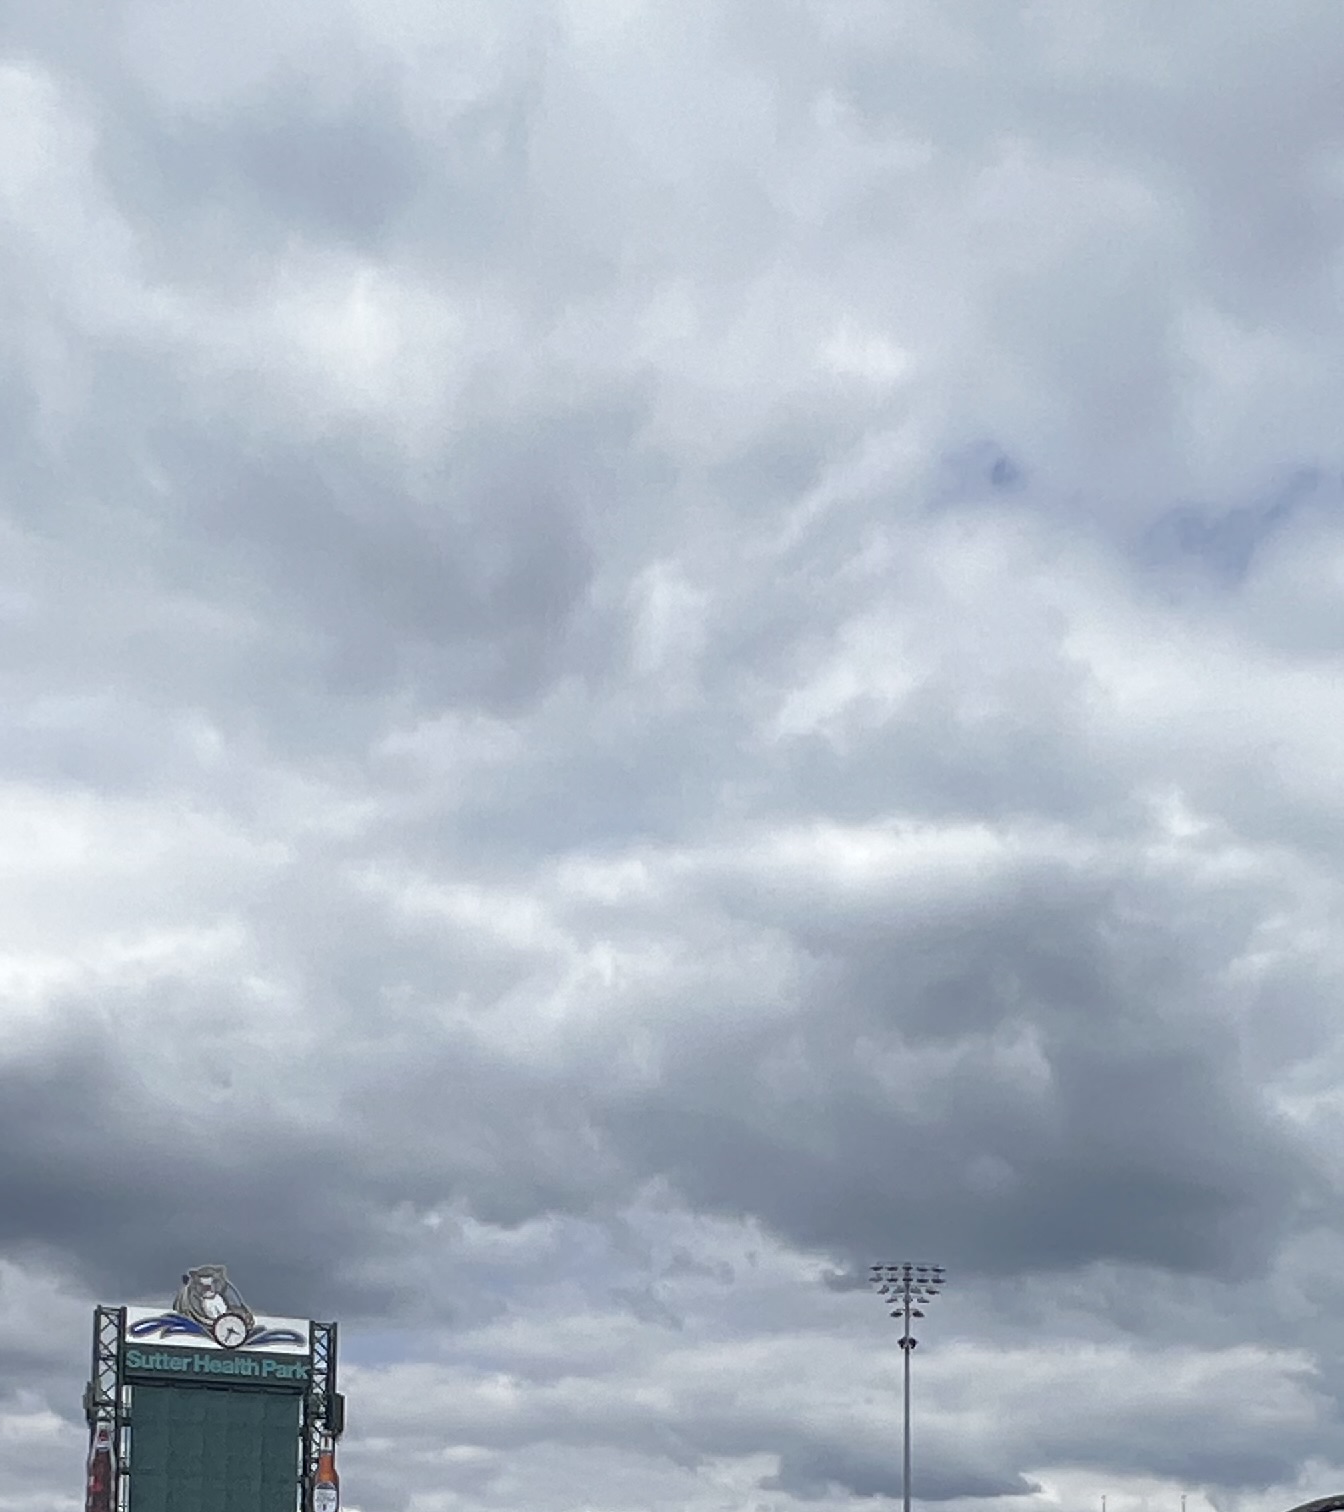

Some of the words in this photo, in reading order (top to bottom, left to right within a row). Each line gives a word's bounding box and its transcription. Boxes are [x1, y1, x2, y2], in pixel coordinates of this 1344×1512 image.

[126, 1349, 192, 1371] Sutter
[193, 1354, 260, 1377] Health
[261, 1359, 311, 1380] Park
